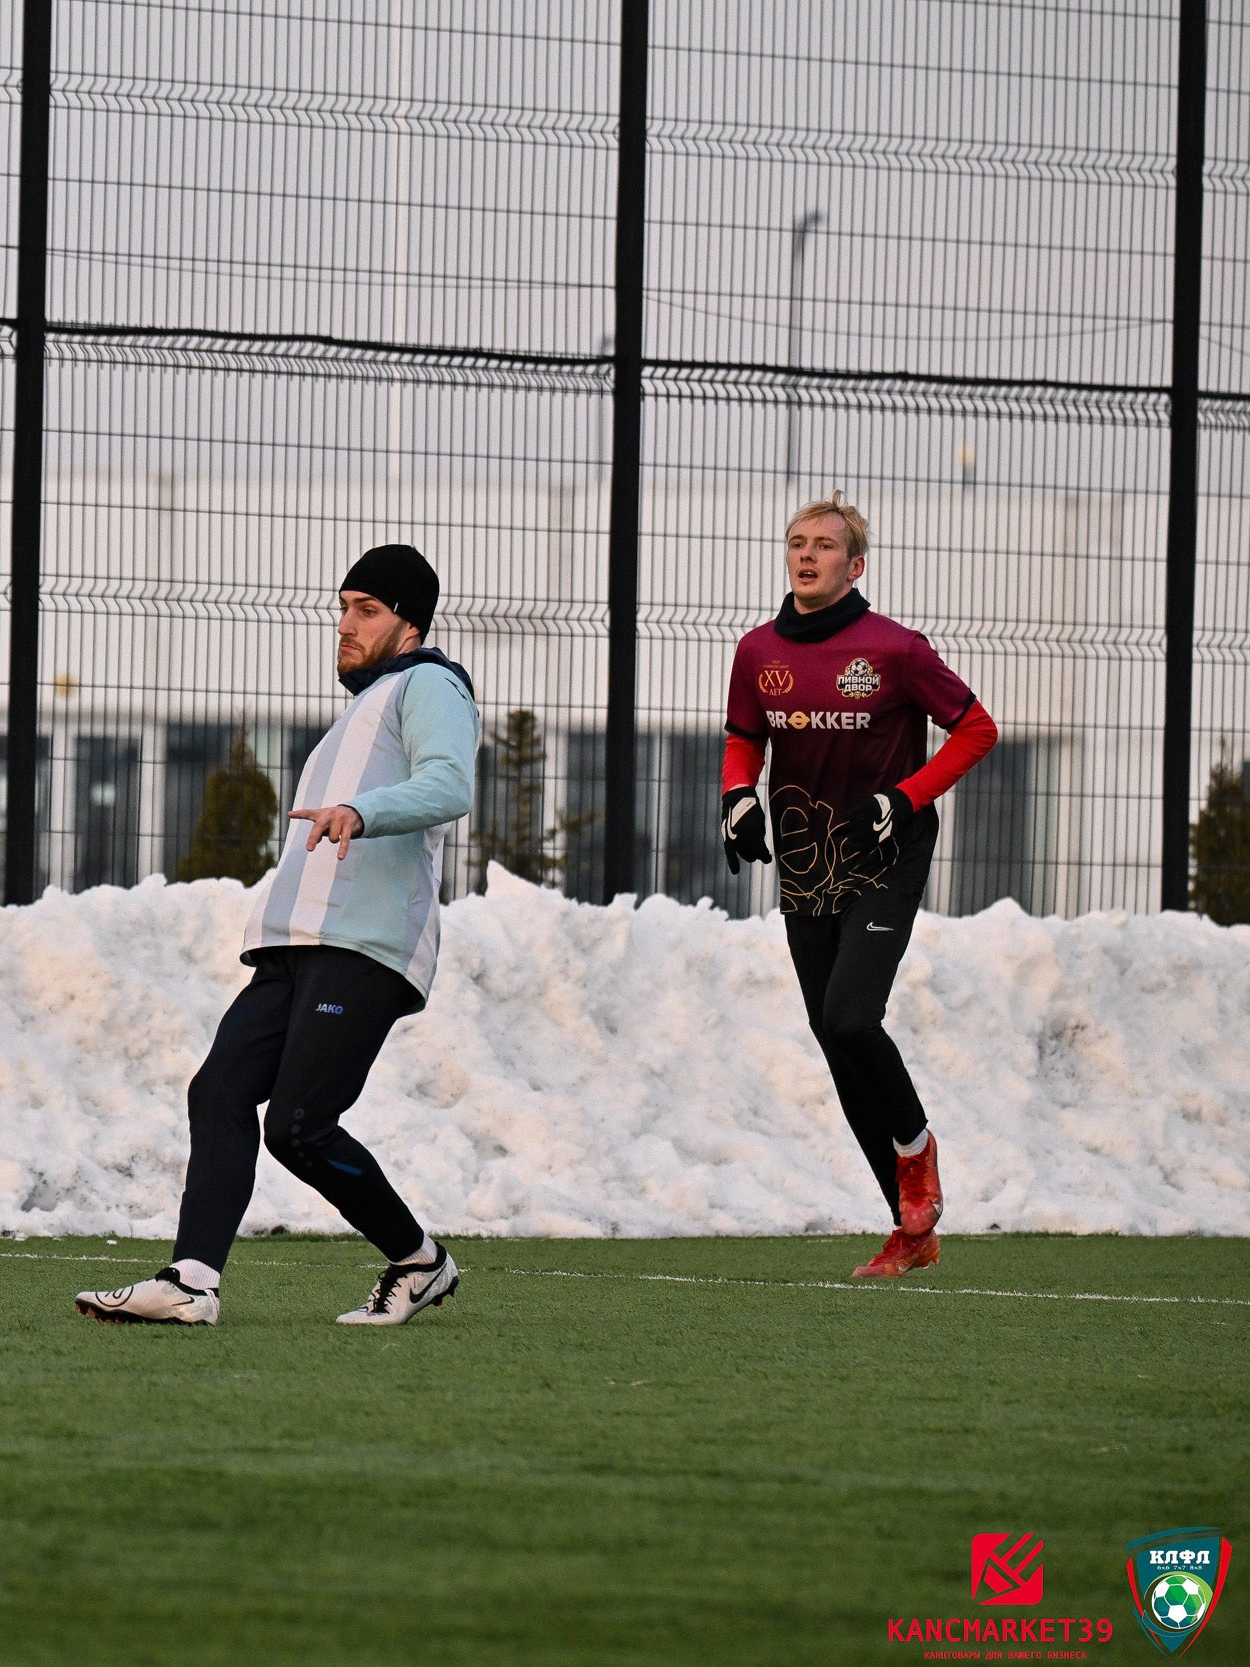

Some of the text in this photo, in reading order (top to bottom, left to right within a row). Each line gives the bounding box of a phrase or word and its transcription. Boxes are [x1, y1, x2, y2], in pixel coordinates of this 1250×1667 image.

[764, 670, 789, 687] XV
[838, 674, 879, 685] ПИВНОЙ
[844, 683, 872, 693] ДВОР
[766, 710, 871, 730] BROKKER
[315, 1003, 343, 1015] JAKO
